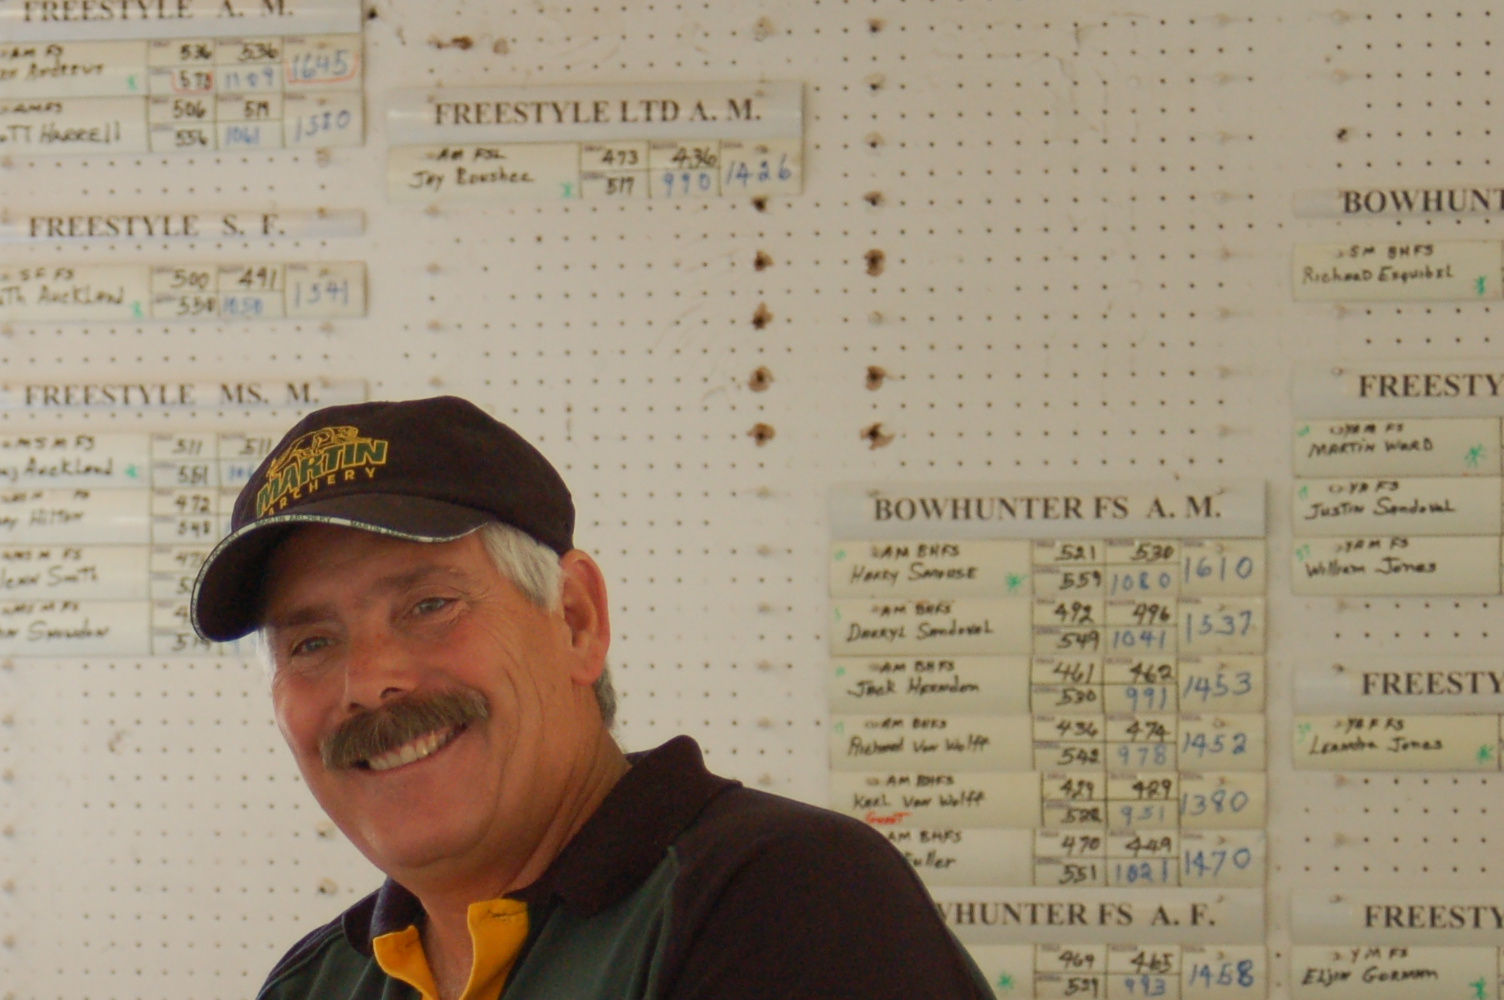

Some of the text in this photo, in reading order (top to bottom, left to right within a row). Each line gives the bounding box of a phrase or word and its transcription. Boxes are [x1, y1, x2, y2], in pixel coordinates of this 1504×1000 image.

[24, 0, 294, 21] FREESTYLE A. M.
[291, 48, 348, 80] 1645
[433, 96, 763, 126] FREESTYLE LTD A. M.
[295, 109, 351, 143] 1580
[601, 148, 639, 166] 473
[726, 152, 792, 187] 1426
[663, 172, 711, 197] 990
[29, 213, 286, 238] FREESTYLE S. F.
[238, 266, 277, 290] 491
[296, 279, 348, 308] 1541
[26, 381, 319, 406] FREESTYLE MS. M.
[1358, 373, 1504, 399] FREESTY
[171, 438, 203, 456] 511
[256, 439, 389, 519] MARTIN
[267, 466, 376, 516] ARCHERY
[875, 495, 1222, 522] BOWHUNTER FS A. M.
[1111, 571, 1172, 597] 1080
[1185, 555, 1254, 584] 1610
[1054, 601, 1253, 644] 492 496 1537
[1112, 630, 1167, 650] 1041
[1052, 660, 1253, 702] 461 462 1453
[1361, 670, 1504, 696] FREESTY
[1124, 686, 1168, 712] 991
[1056, 719, 1248, 758] 436 474 1452
[1117, 742, 1168, 766] 978
[1131, 778, 1173, 802] 429
[1178, 789, 1249, 817] 1380
[1120, 805, 1166, 828] 951
[1057, 856, 1169, 886] 551 1021
[1061, 835, 1252, 881] 470 449 1470
[1097, 899, 1134, 927] FS
[1150, 899, 1180, 926] A.
[1189, 898, 1217, 926] F.
[1364, 904, 1504, 930] FREESTY
[1058, 949, 1095, 970] 469
[1188, 959, 1255, 989] 1458
[1123, 973, 1168, 998] 993
